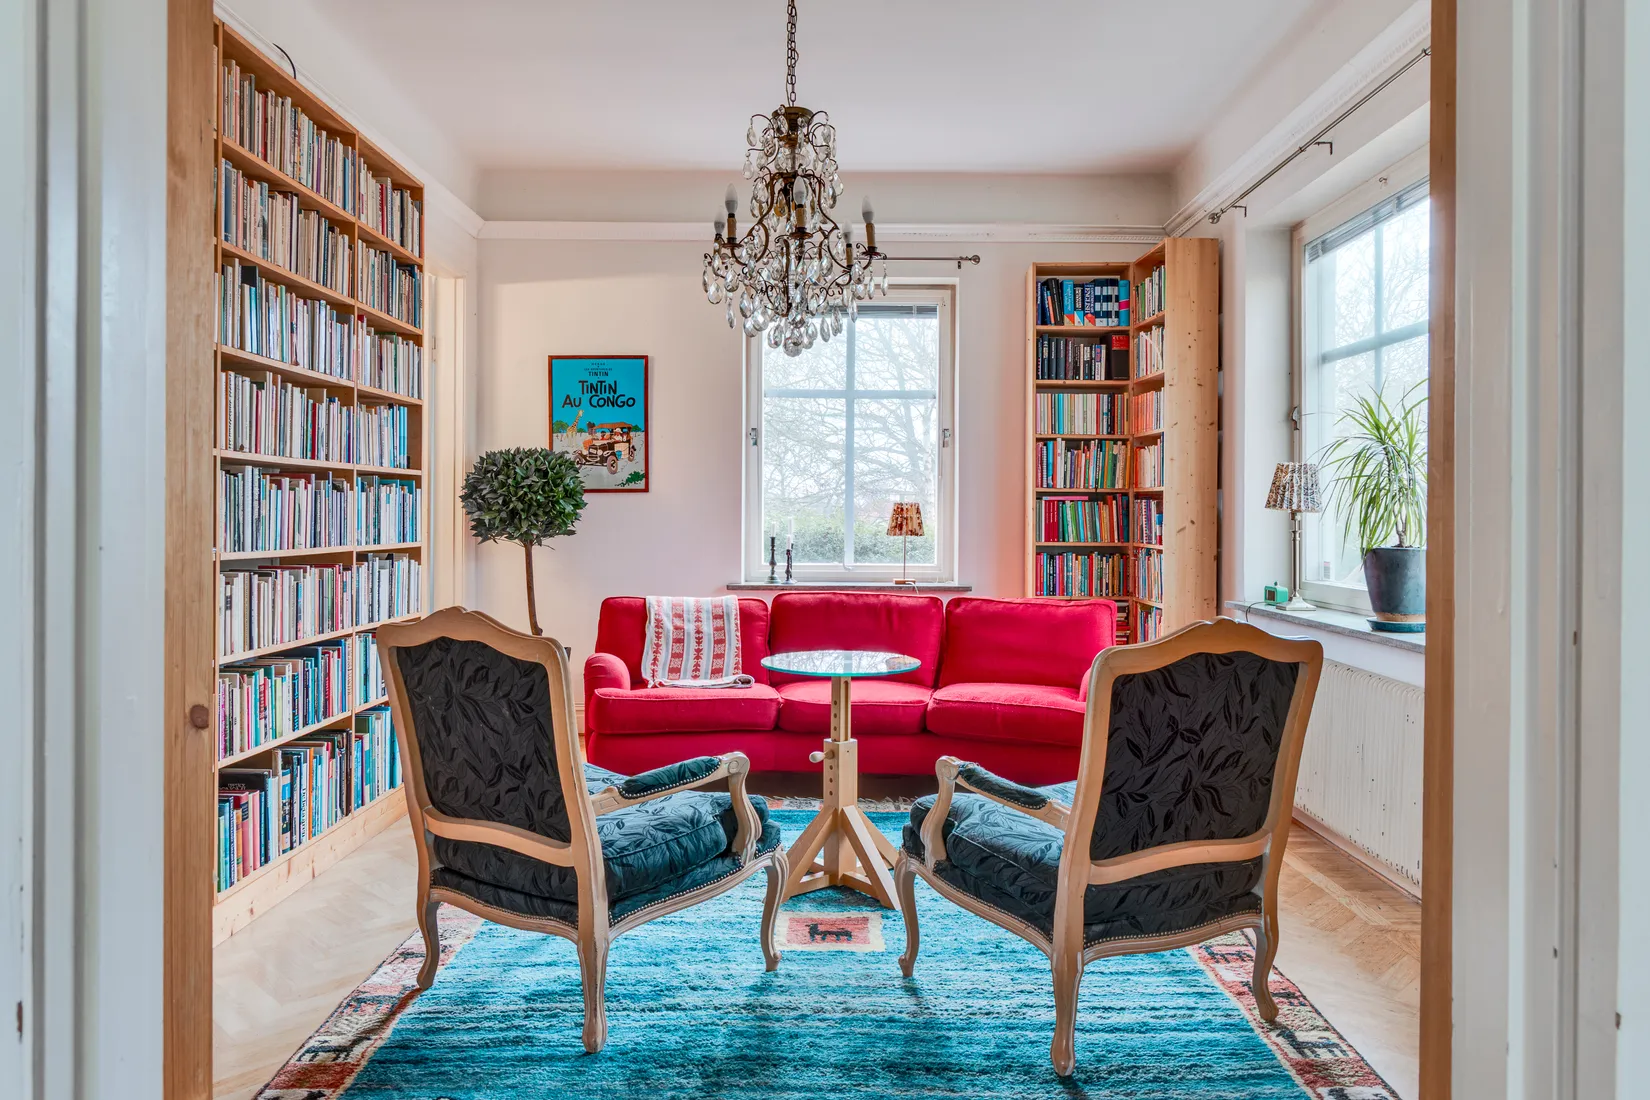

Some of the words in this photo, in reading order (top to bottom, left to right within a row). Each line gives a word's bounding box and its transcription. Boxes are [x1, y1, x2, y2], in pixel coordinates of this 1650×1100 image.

[578, 380, 616, 394] TINTIN
[562, 394, 582, 408] AU
[589, 394, 636, 408] CONGO
